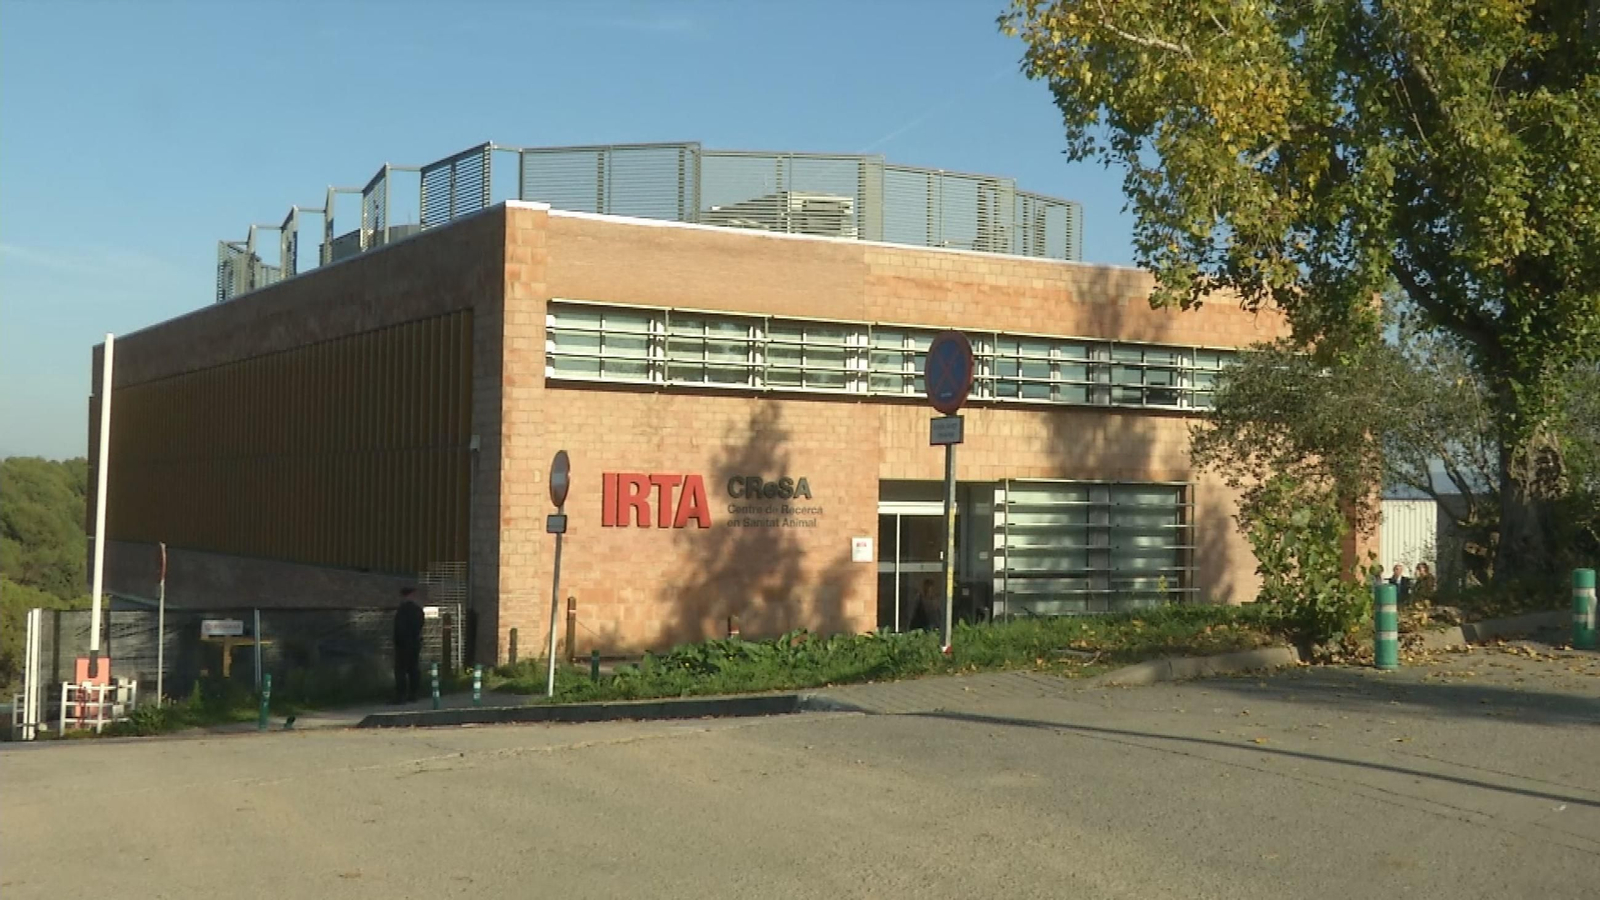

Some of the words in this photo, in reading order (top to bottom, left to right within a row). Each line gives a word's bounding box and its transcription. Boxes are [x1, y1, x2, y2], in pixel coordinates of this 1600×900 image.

[727, 476, 812, 499] CReSA
[602, 473, 712, 528] IRTA
[727, 503, 762, 514] Centre
[765, 504, 778, 514] de
[781, 504, 823, 515] Recerca
[727, 519, 740, 527] en
[743, 518, 779, 527] Sanitat
[782, 518, 817, 527] Animal
